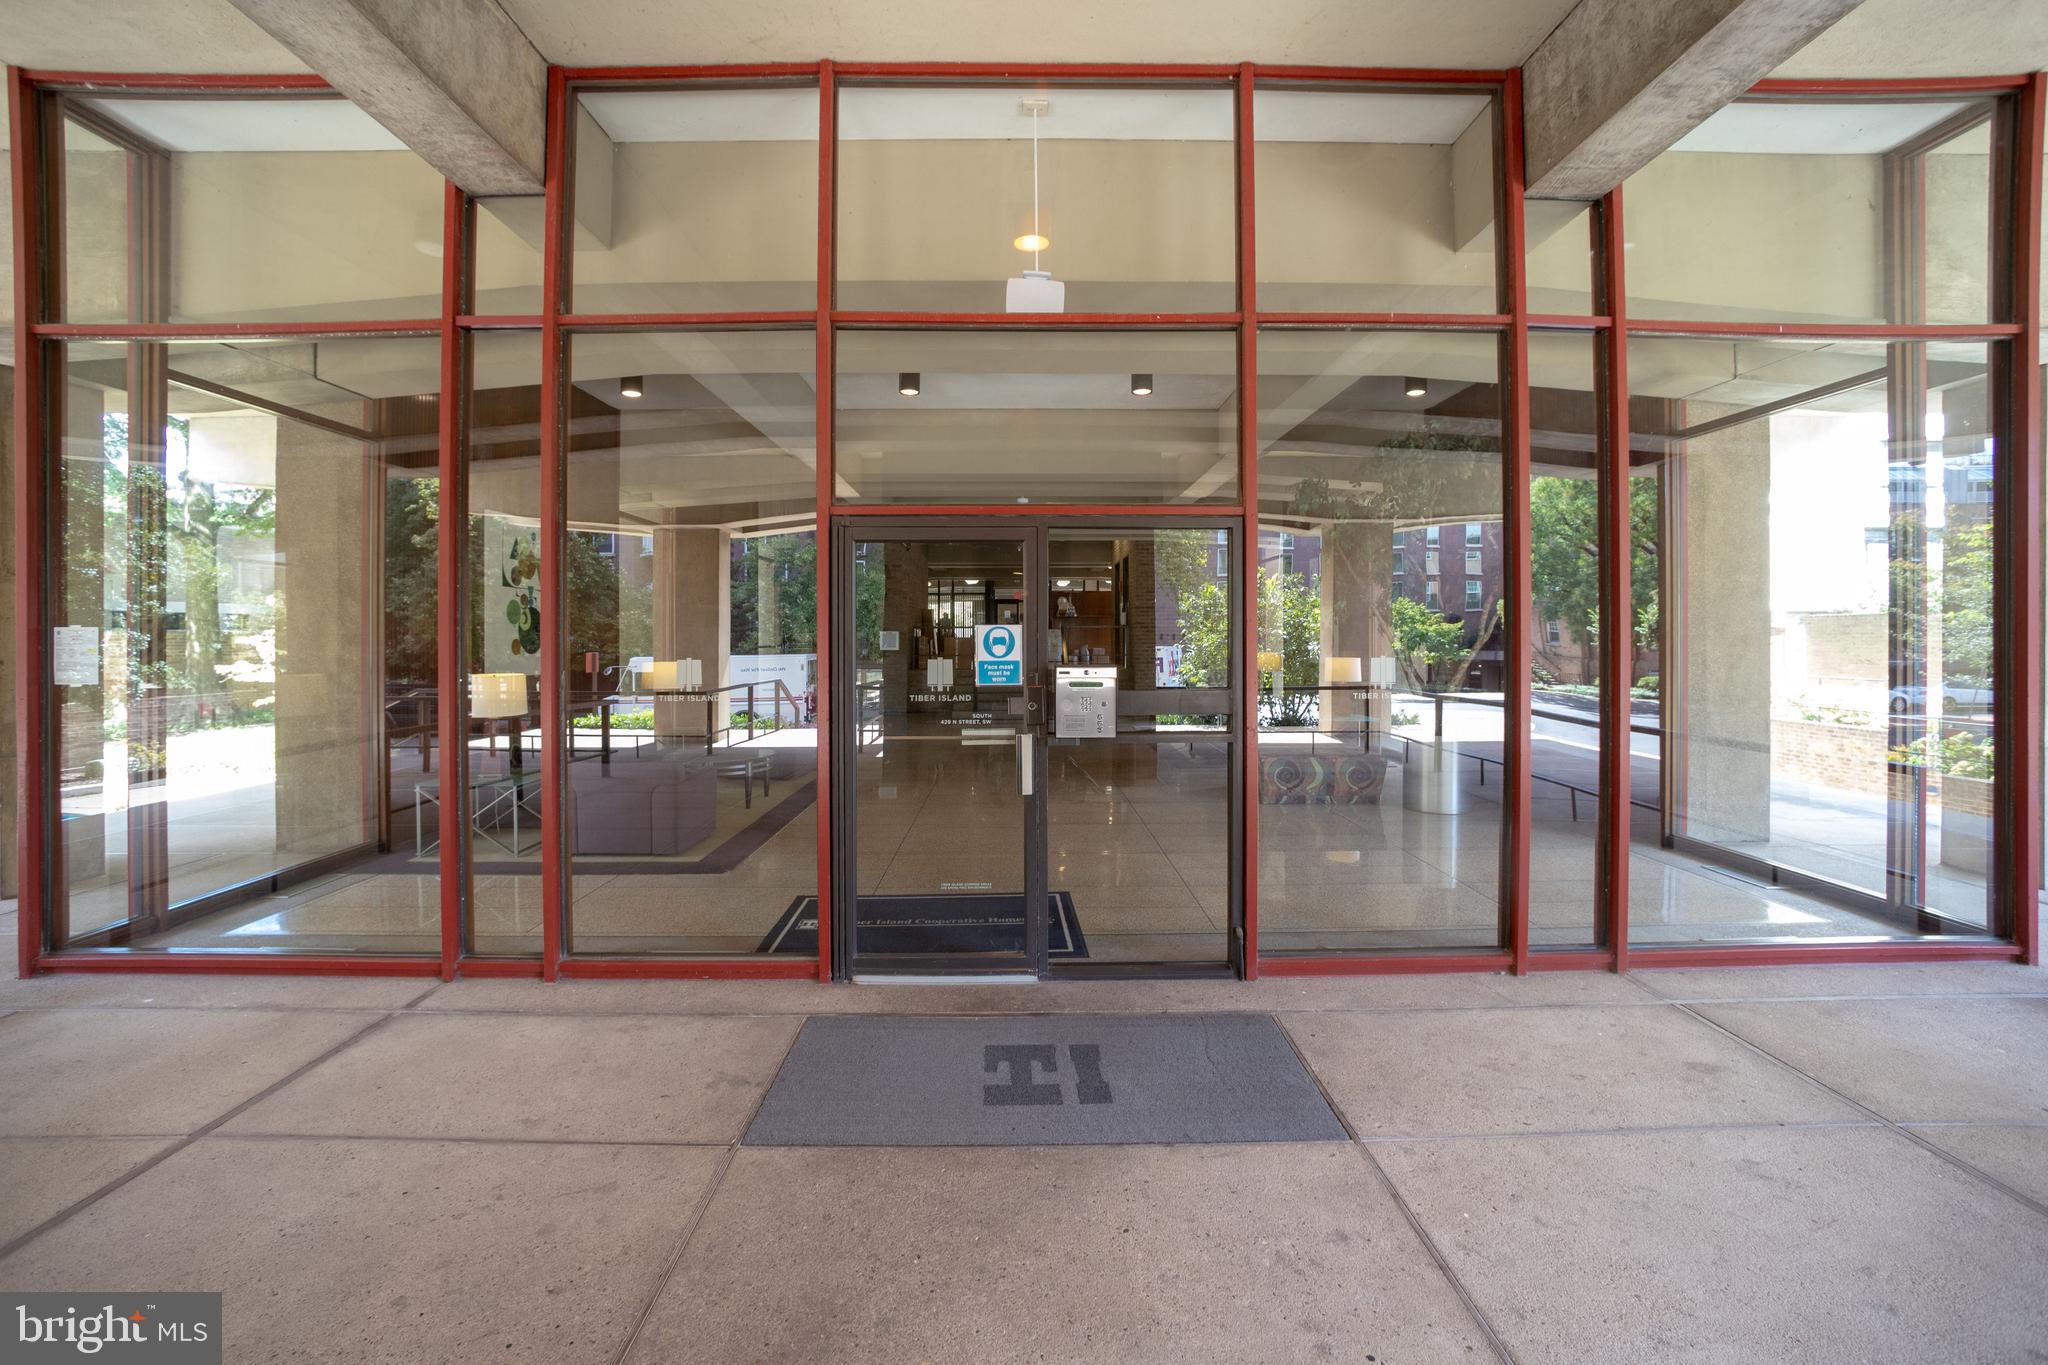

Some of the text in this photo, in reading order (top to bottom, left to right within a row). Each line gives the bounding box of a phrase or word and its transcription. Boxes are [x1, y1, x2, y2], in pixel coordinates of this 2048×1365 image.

[659, 694, 719, 702] TIBER ISLAND
[909, 694, 972, 702] TIBER ISLAND
[1352, 692, 1379, 700] TIBER
[983, 1044, 1113, 1105] TI
